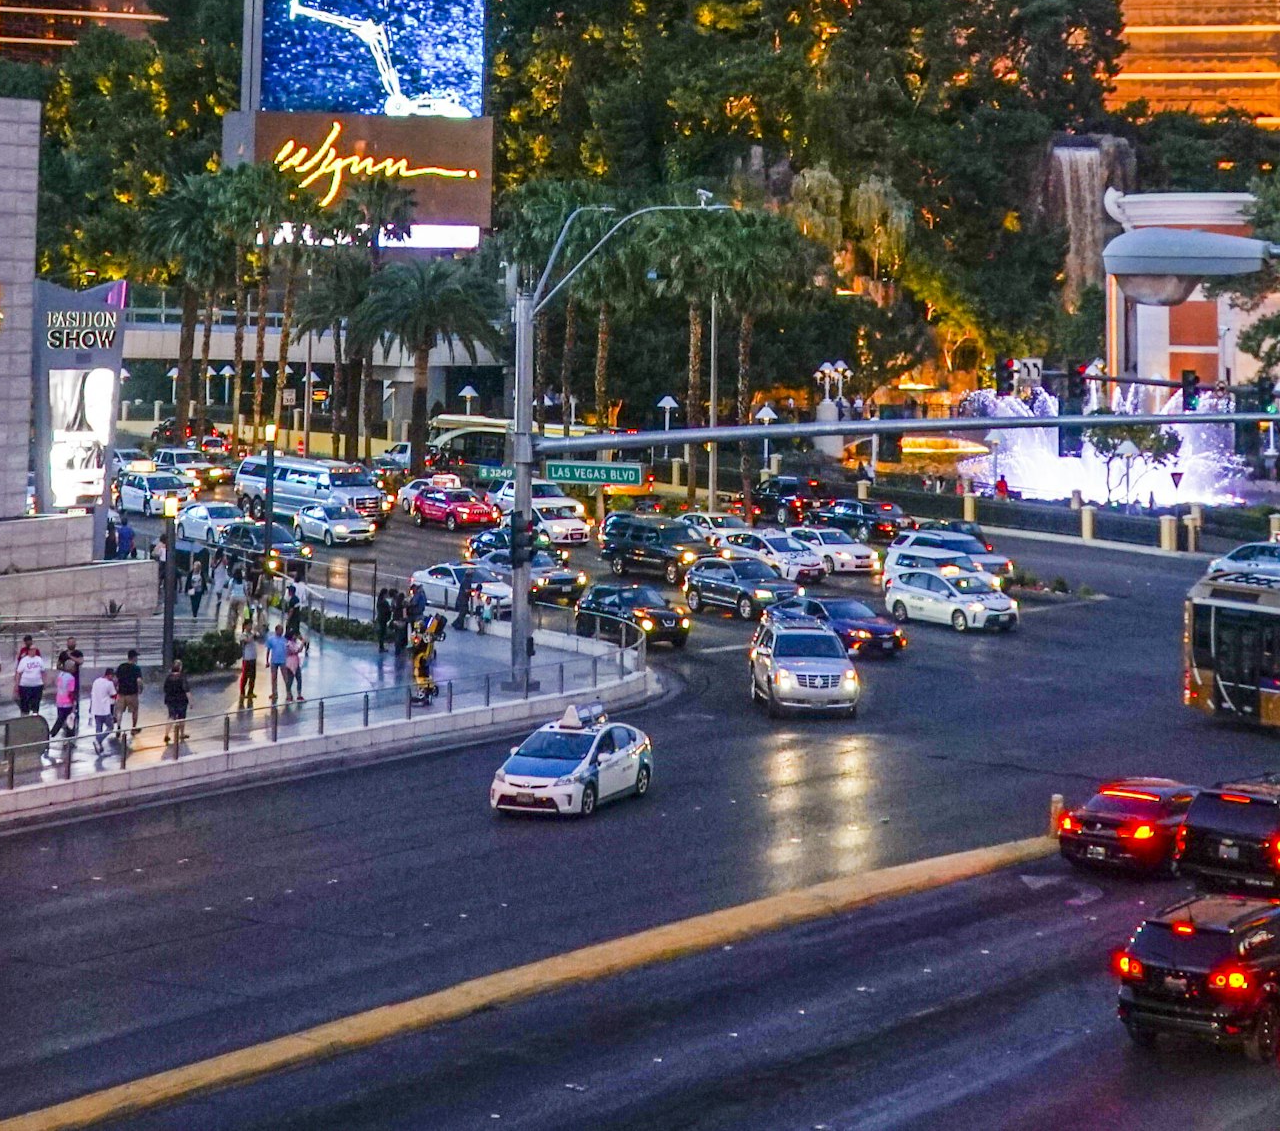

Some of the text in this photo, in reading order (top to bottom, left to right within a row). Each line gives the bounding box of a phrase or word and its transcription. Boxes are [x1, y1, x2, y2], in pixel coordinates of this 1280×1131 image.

[46, 310, 117, 329] FASHION
[46, 329, 117, 351] SHOW
[481, 468, 513, 478] S 3249
[551, 466, 636, 482] LAS VEGAS BLVD
